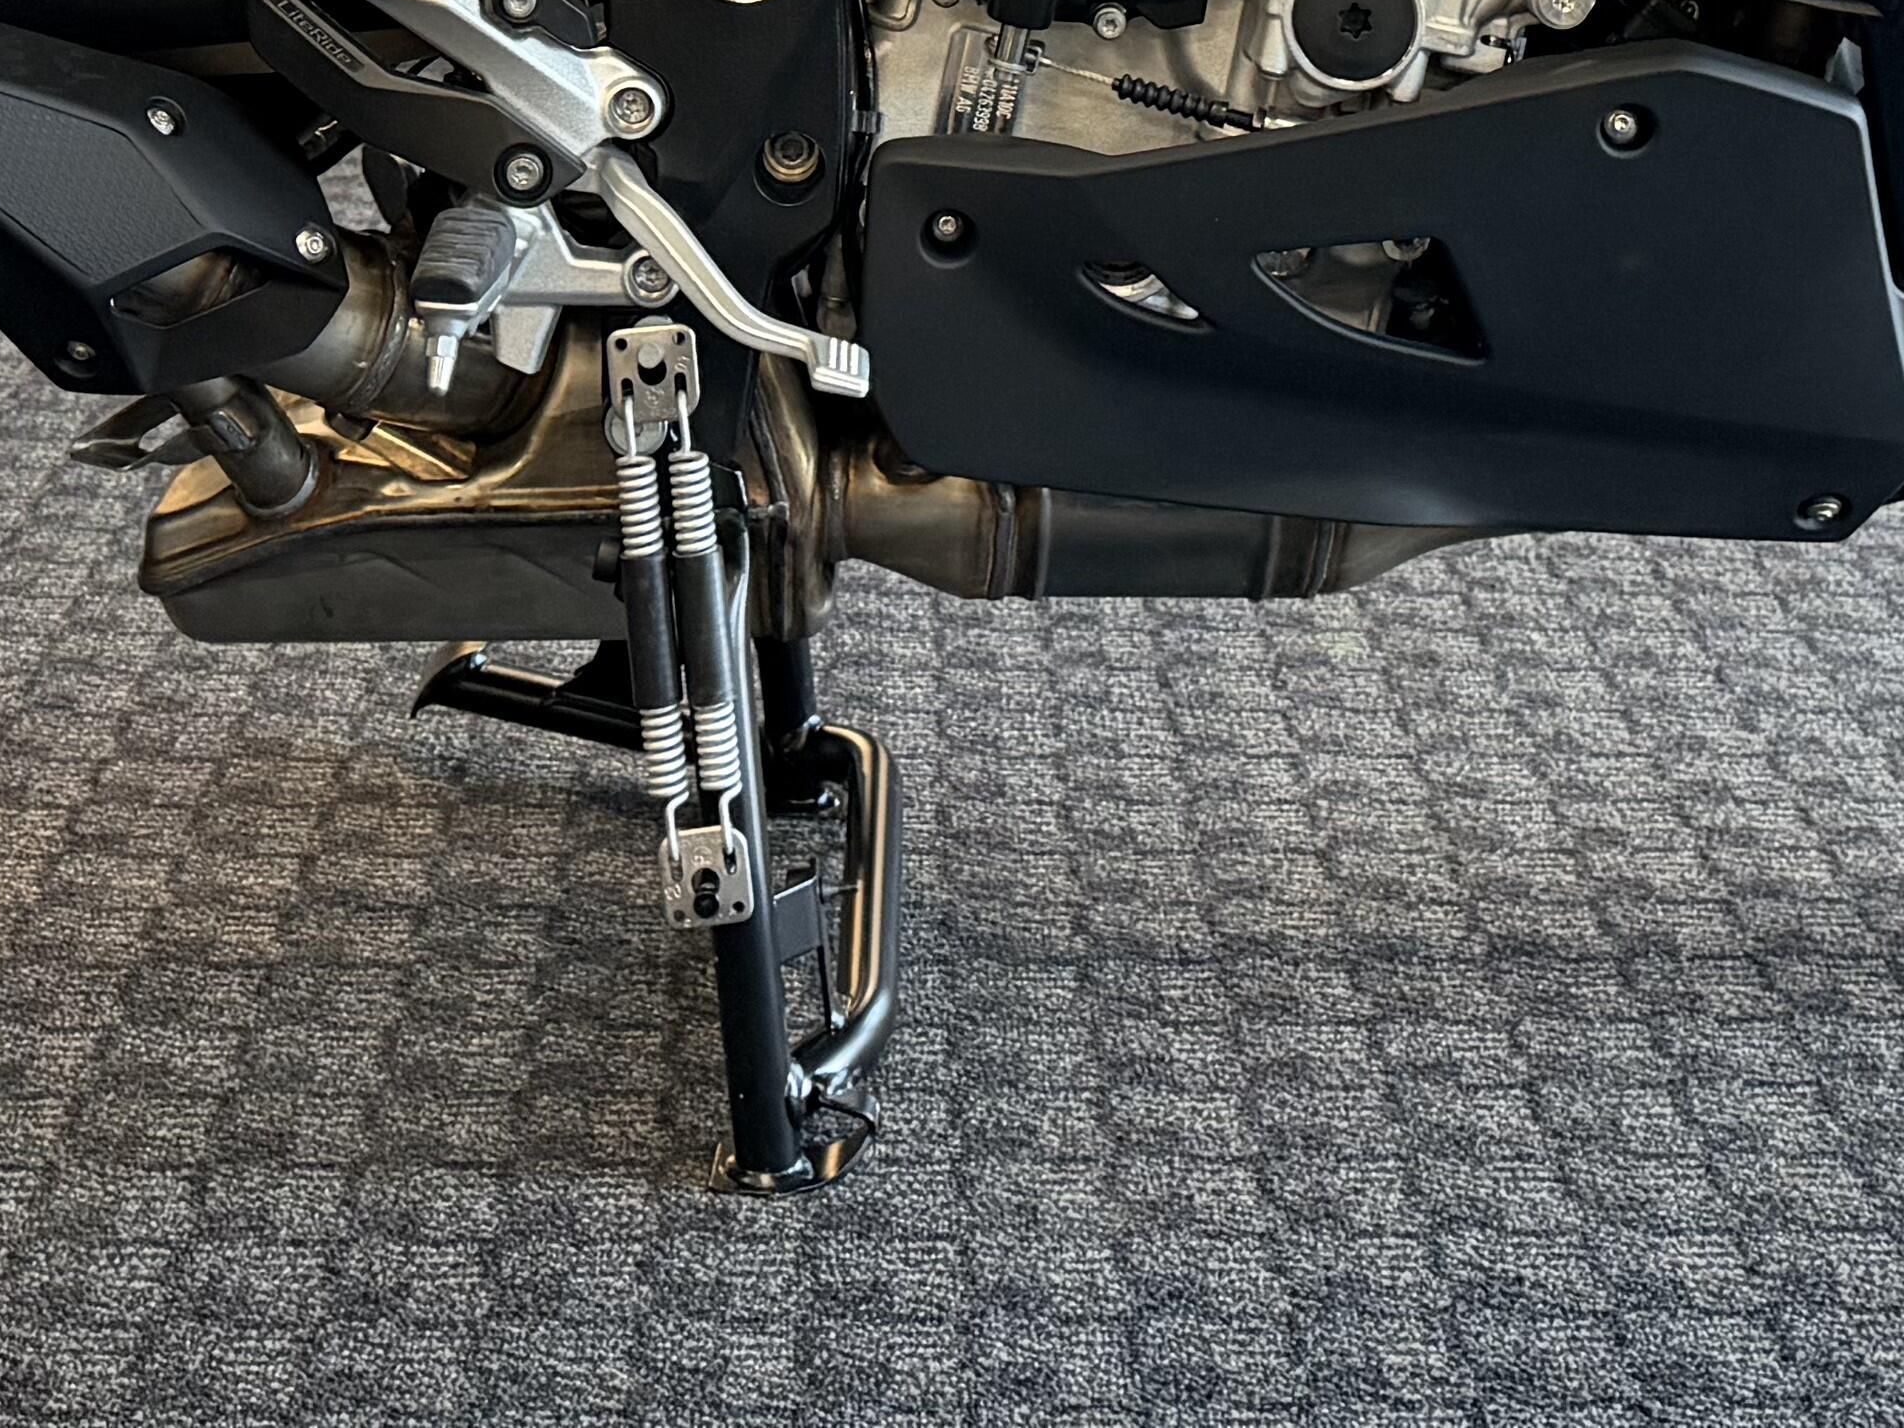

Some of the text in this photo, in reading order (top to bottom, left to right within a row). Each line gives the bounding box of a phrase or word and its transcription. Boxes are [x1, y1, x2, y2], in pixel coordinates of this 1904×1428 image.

[277, 0, 352, 64] LiteRide
[955, 65, 981, 114] BMW AG
